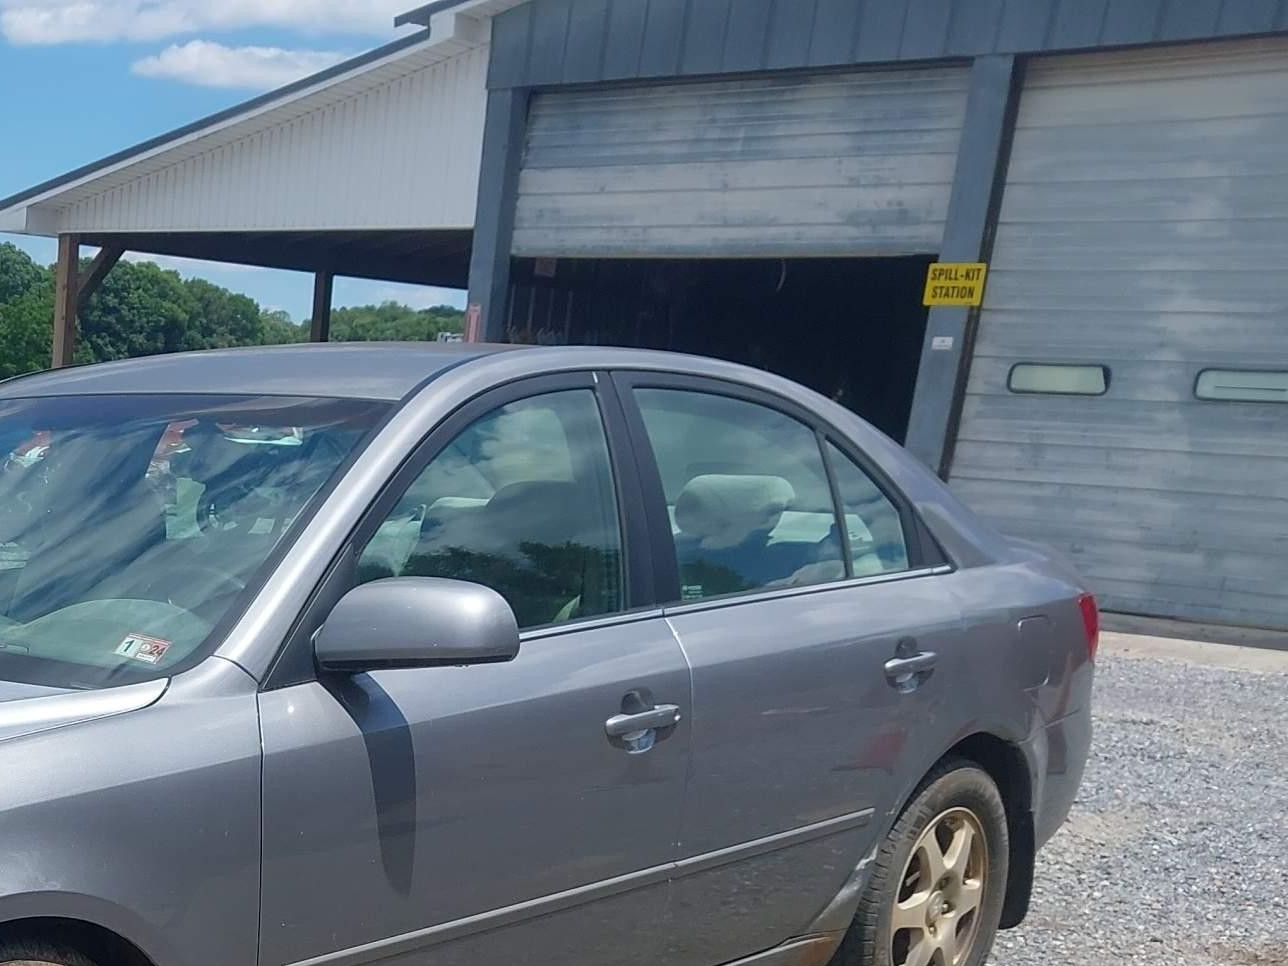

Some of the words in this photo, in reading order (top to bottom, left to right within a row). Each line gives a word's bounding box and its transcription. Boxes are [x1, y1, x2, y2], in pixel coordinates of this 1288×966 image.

[931, 268, 982, 281] SPILL-KIT
[932, 286, 975, 299] STATION
[124, 639, 135, 652] 1
